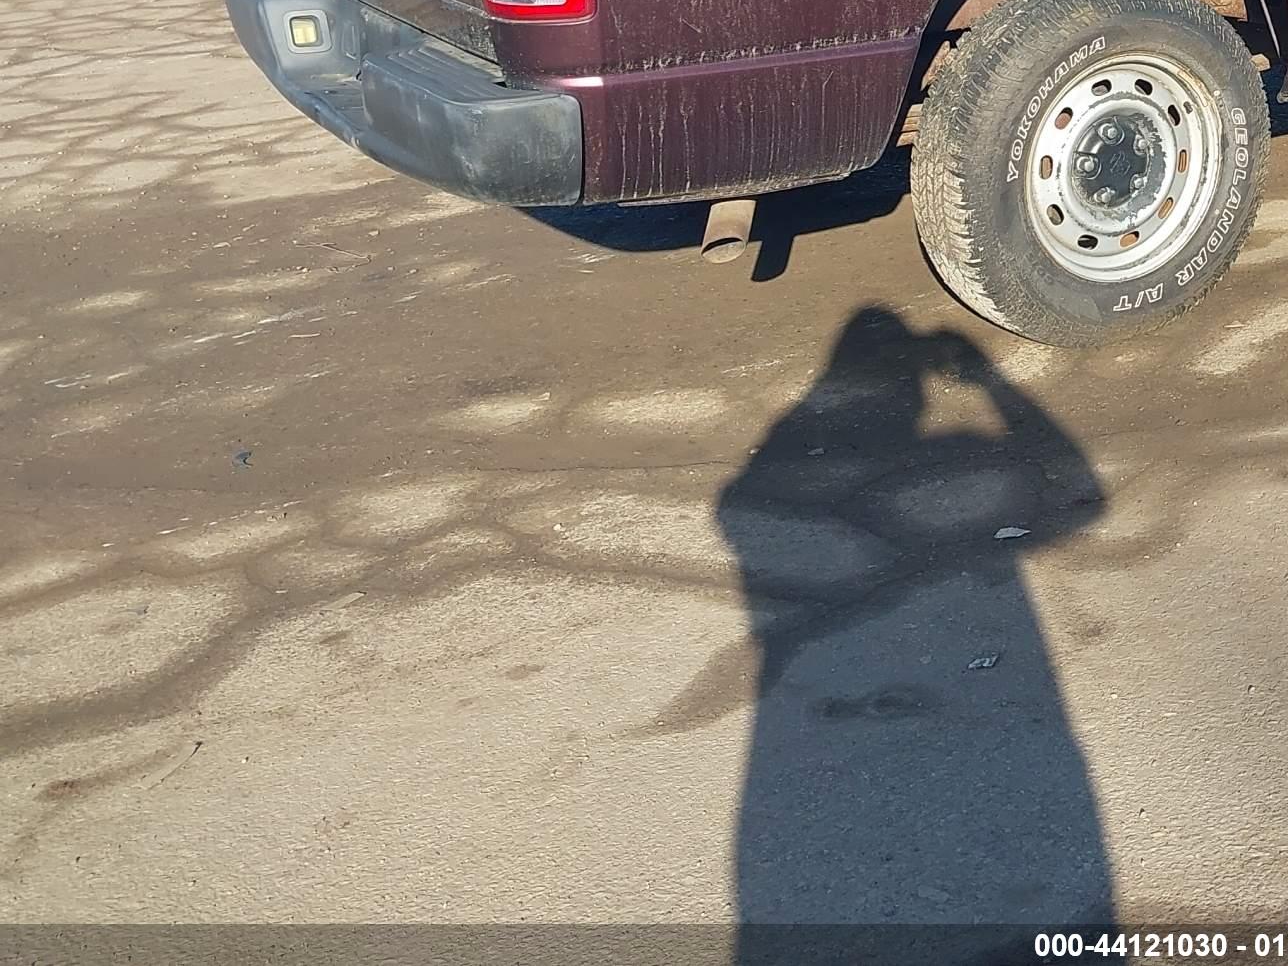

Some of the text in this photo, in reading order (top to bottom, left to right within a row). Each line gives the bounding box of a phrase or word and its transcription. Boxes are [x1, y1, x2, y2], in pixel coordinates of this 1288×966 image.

[1006, 36, 1106, 183] YOKOHAMA
[1112, 106, 1248, 312] GEOLANDAR A/T
